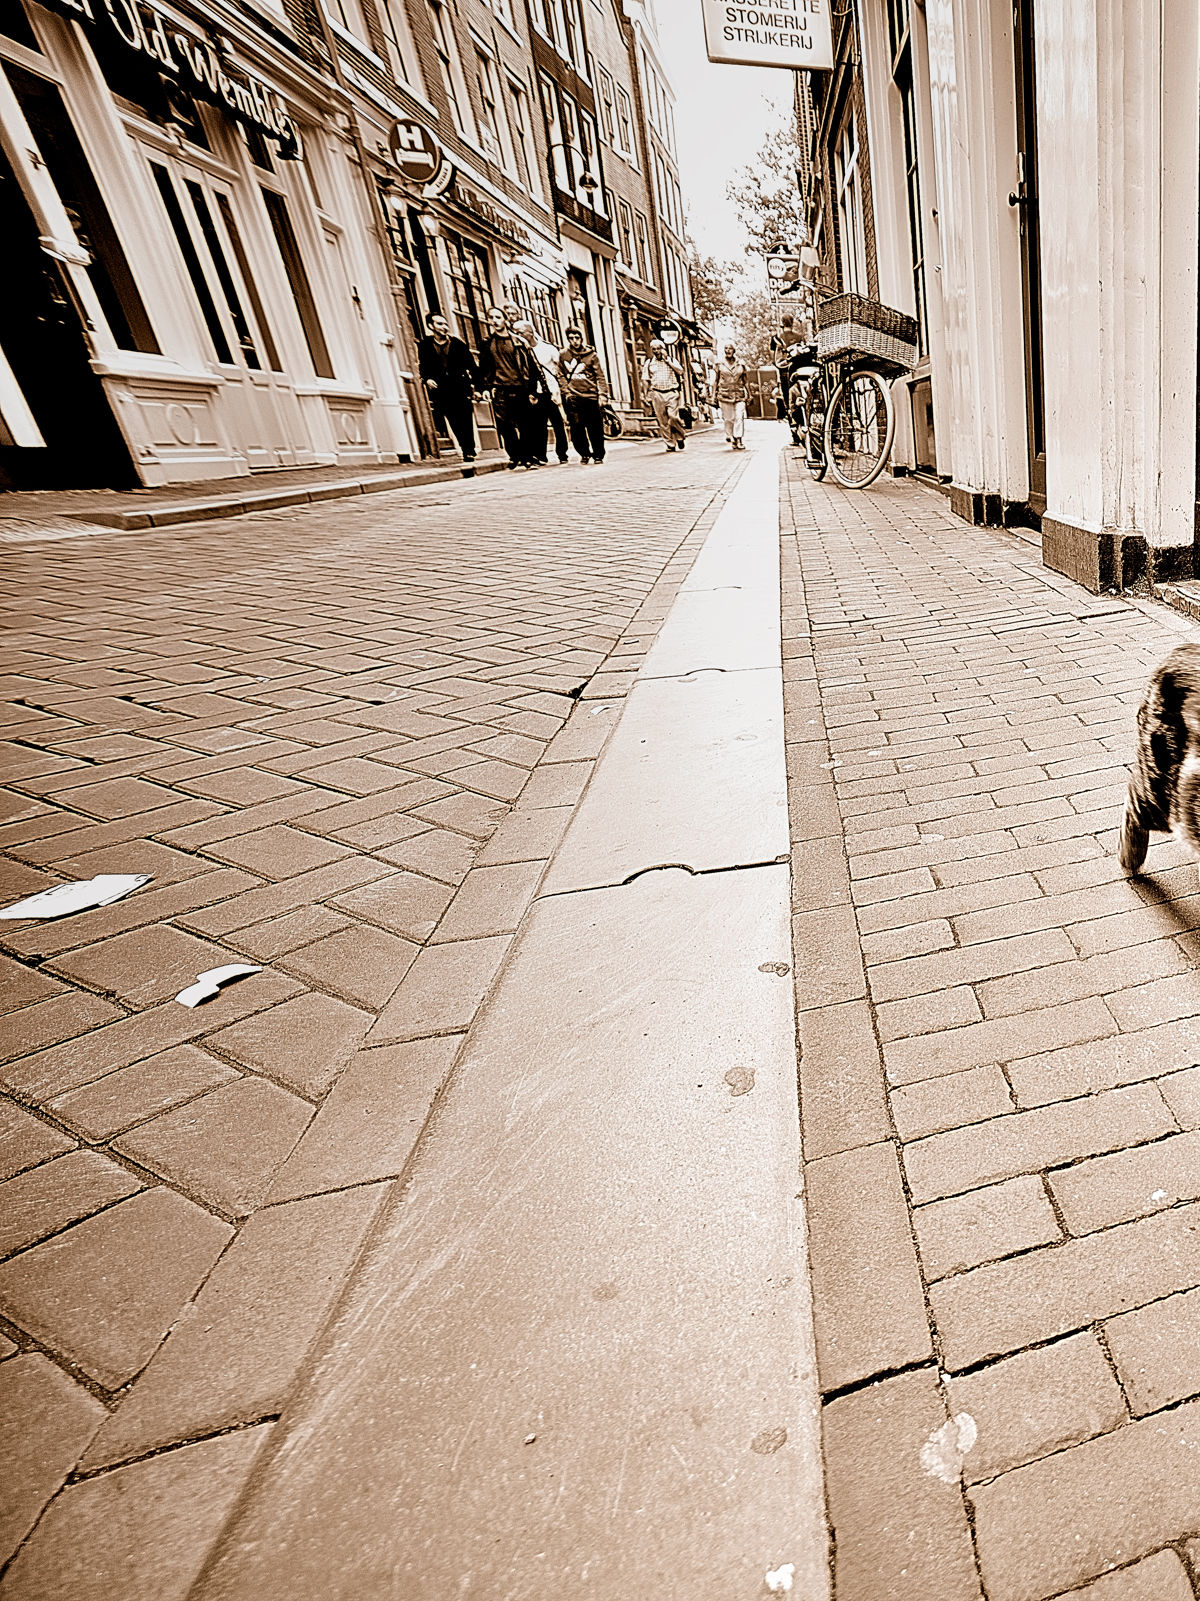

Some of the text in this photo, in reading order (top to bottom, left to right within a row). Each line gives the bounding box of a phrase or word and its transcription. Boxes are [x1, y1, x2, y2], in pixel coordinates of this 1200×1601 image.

[713, 0, 821, 14] ERETTE
[725, 7, 807, 31] STOMERIJ
[723, 26, 813, 50] STRIJKERIJ
[103, 0, 304, 160] Old Wembley
[396, 123, 425, 151] H
